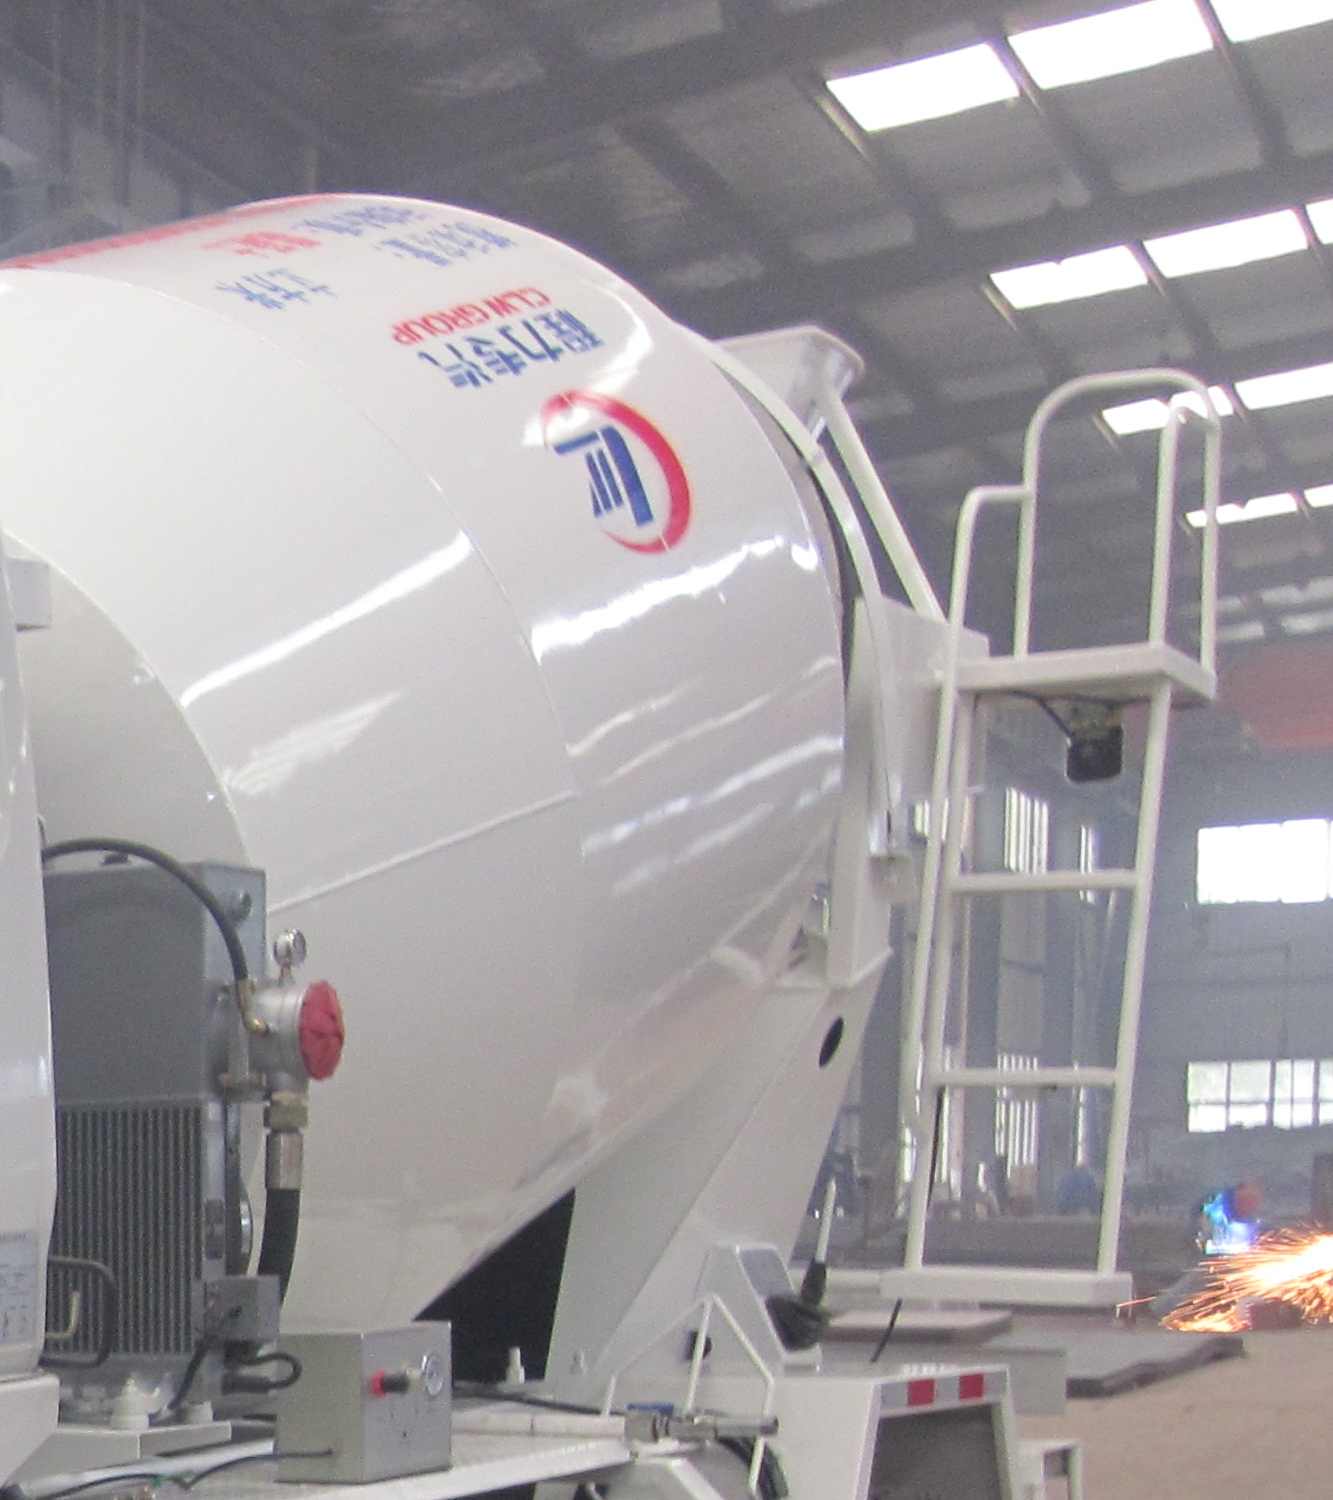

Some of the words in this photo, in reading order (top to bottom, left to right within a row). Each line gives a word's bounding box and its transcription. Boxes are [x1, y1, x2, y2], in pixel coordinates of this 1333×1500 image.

[391, 302, 491, 346] GROUP
[482, 286, 552, 318] CLW
[417, 308, 604, 388] 程力专汽
